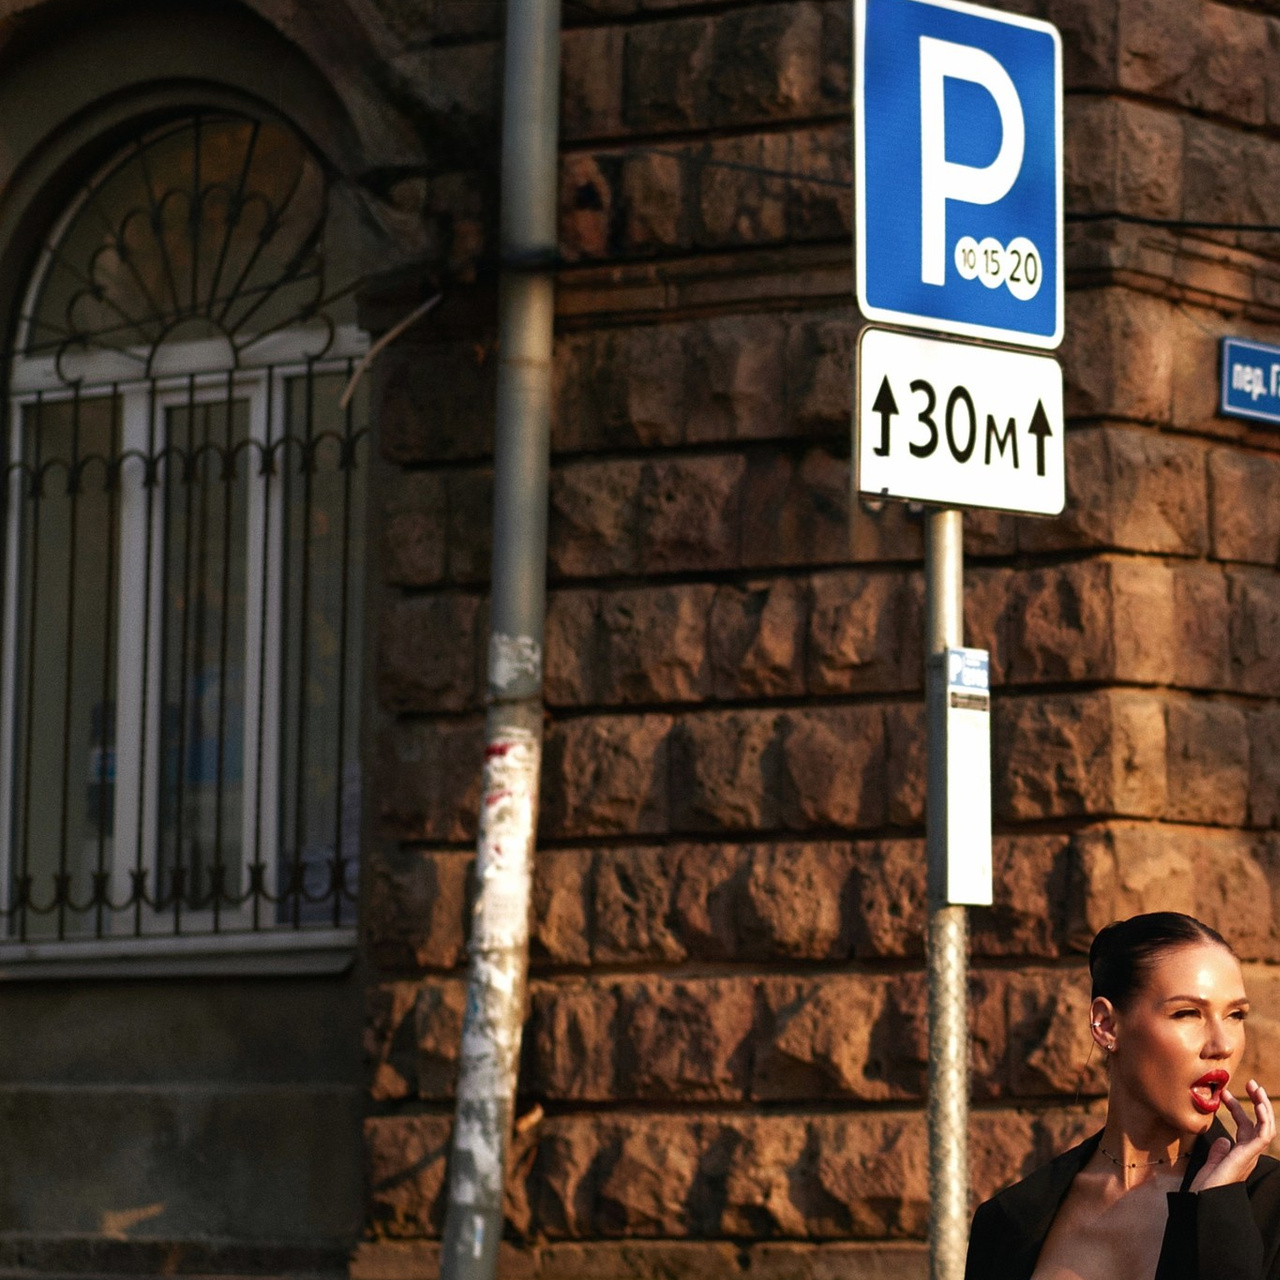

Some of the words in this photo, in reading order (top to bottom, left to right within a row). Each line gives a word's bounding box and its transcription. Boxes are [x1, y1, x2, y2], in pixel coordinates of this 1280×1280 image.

[919, 35, 1025, 286] P
[962, 248, 976, 270] 10
[983, 249, 1001, 276] 15
[1009, 249, 1038, 286] 20
